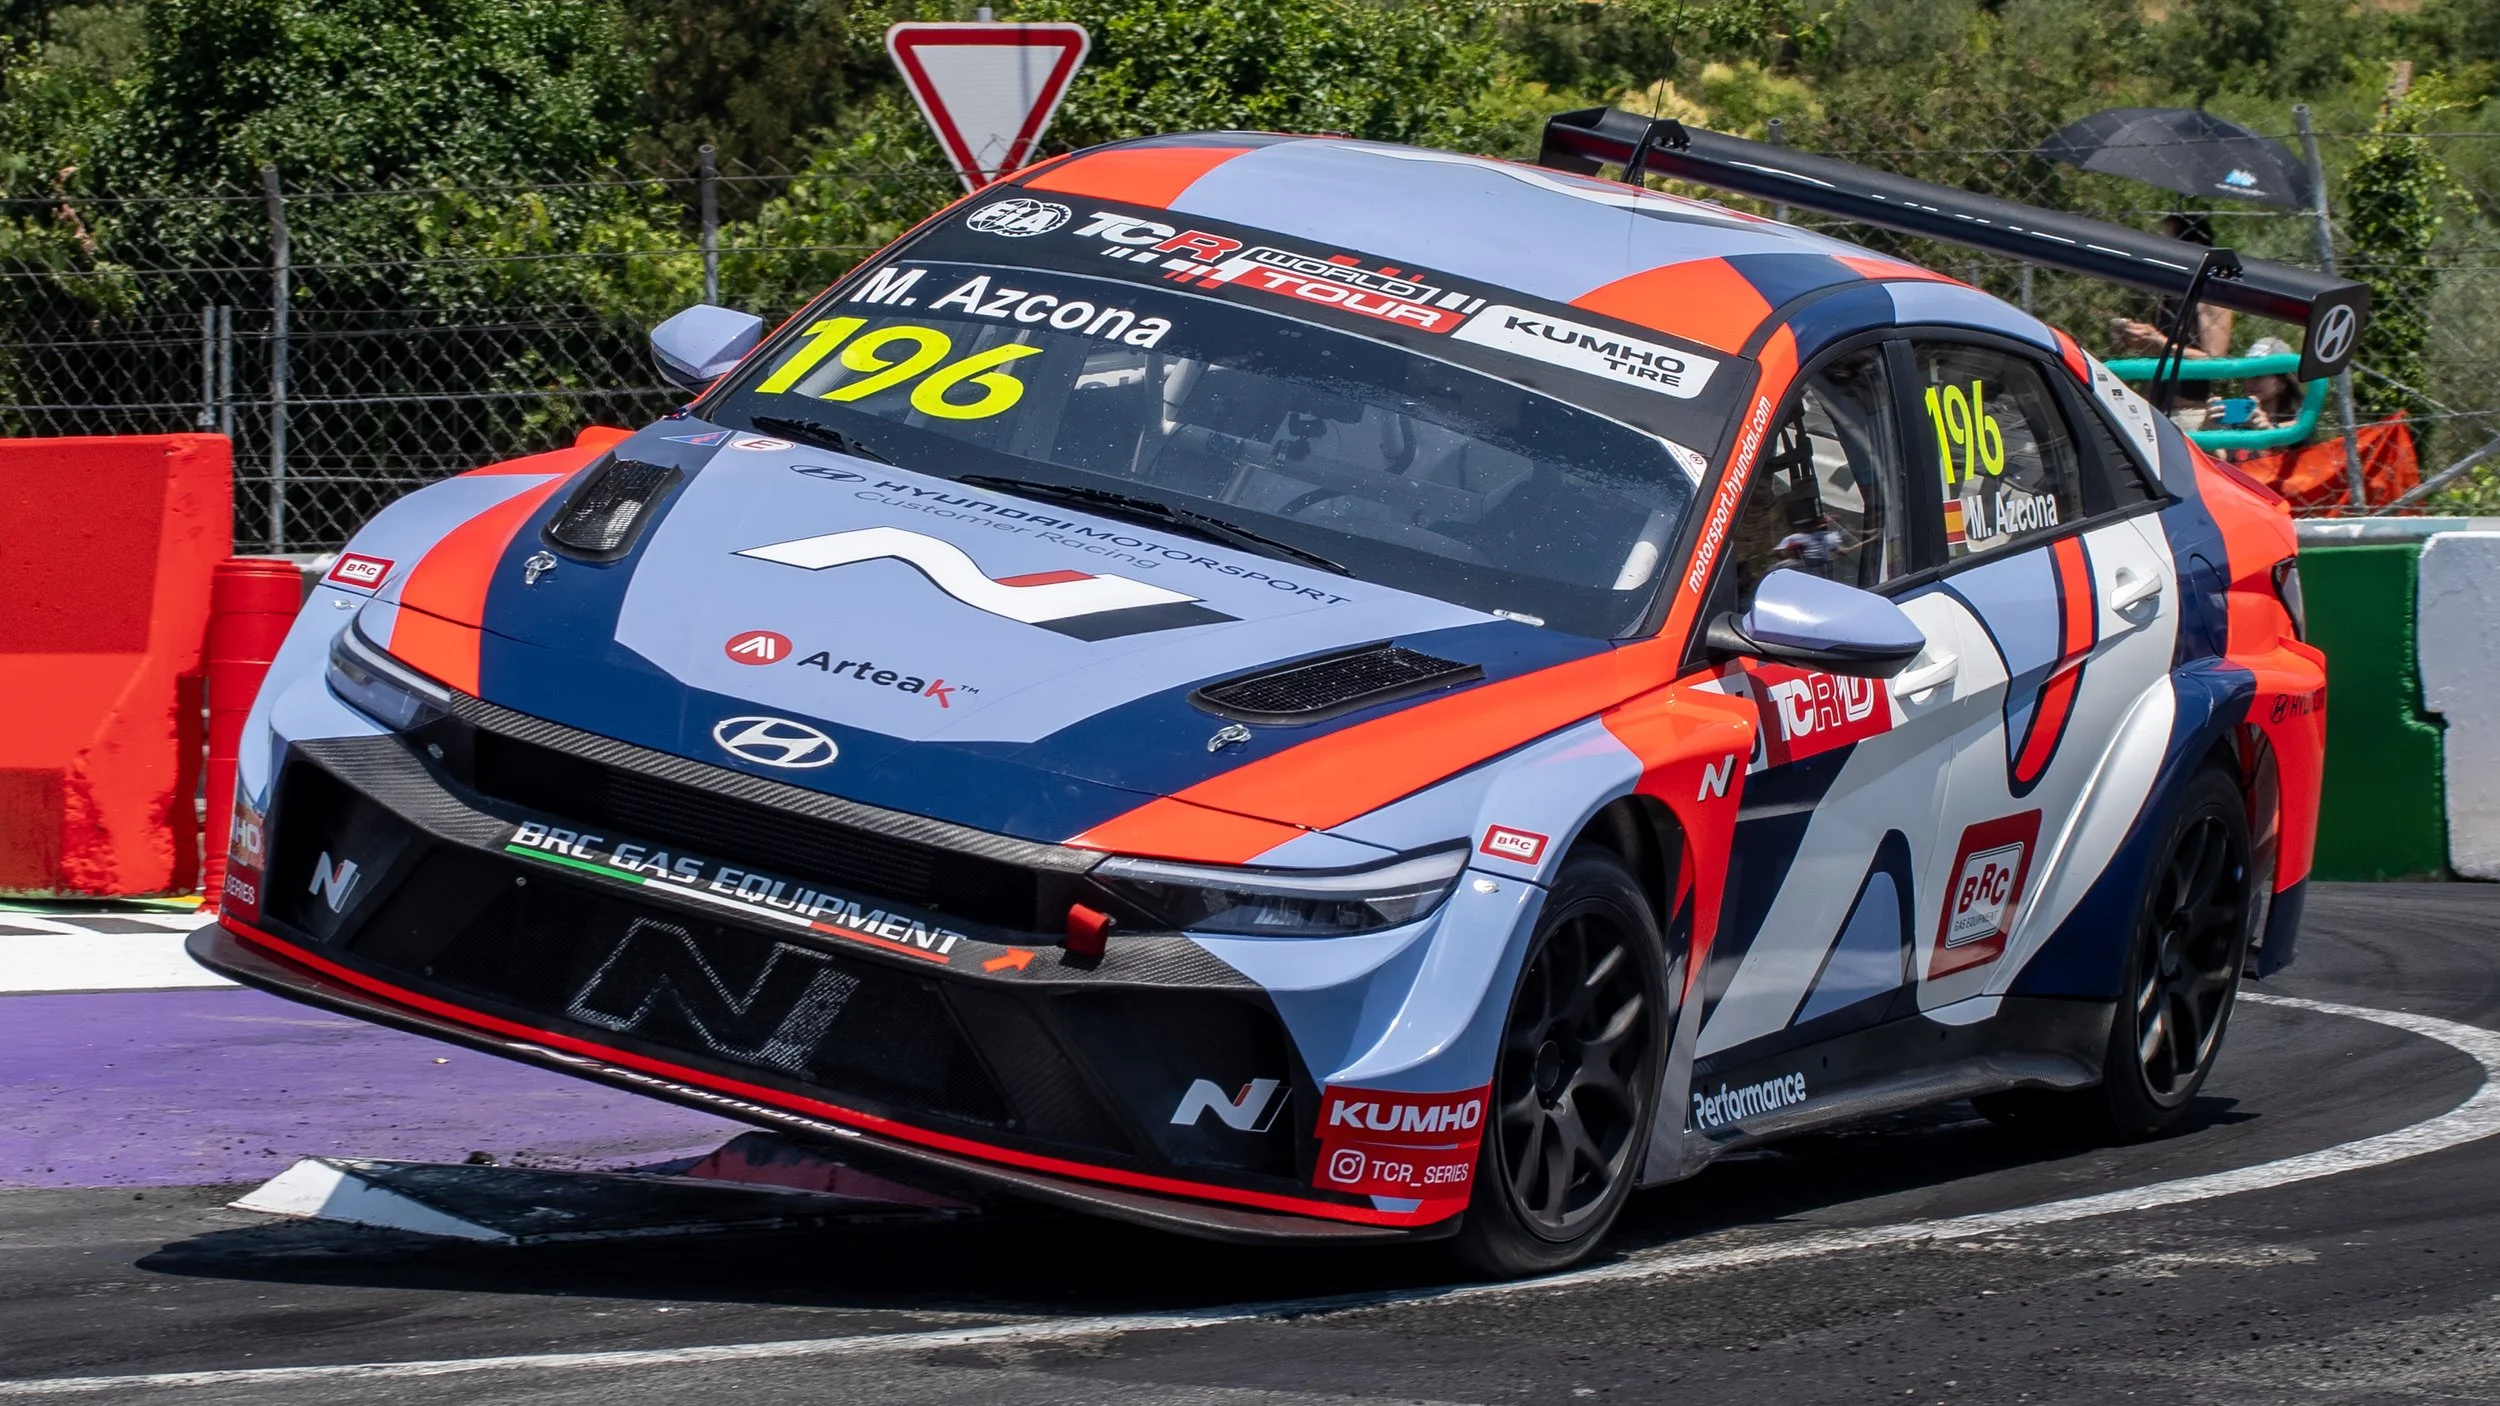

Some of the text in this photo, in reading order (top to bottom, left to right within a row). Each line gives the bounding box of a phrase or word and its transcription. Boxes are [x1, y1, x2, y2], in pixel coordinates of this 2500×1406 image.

[1073, 211, 1243, 263] TCR
[1256, 251, 1418, 294] WORLD
[1263, 271, 1442, 328] TOUR
[850, 267, 1172, 349] M. Azcona
[754, 316, 1044, 420] 196
[1504, 315, 1686, 374] KUMHO
[1603, 357, 1682, 388] TIRE
[1925, 380, 2005, 484] 196
[1688, 395, 1772, 594] motorsport.hyundai.com
[1967, 495, 1992, 539] M.
[853, 489, 1162, 569] Customer Racing
[346, 563, 377, 575] BRC
[1497, 836, 1532, 850] BRC
[510, 820, 968, 955] BRC GAS EQUIPMENT
[1957, 862, 2010, 915] BRC
[1329, 1099, 1482, 1133] KUMHO
[1693, 1071, 1807, 1130] Performance
[1371, 1160, 1469, 1188] TCR_SERIES
